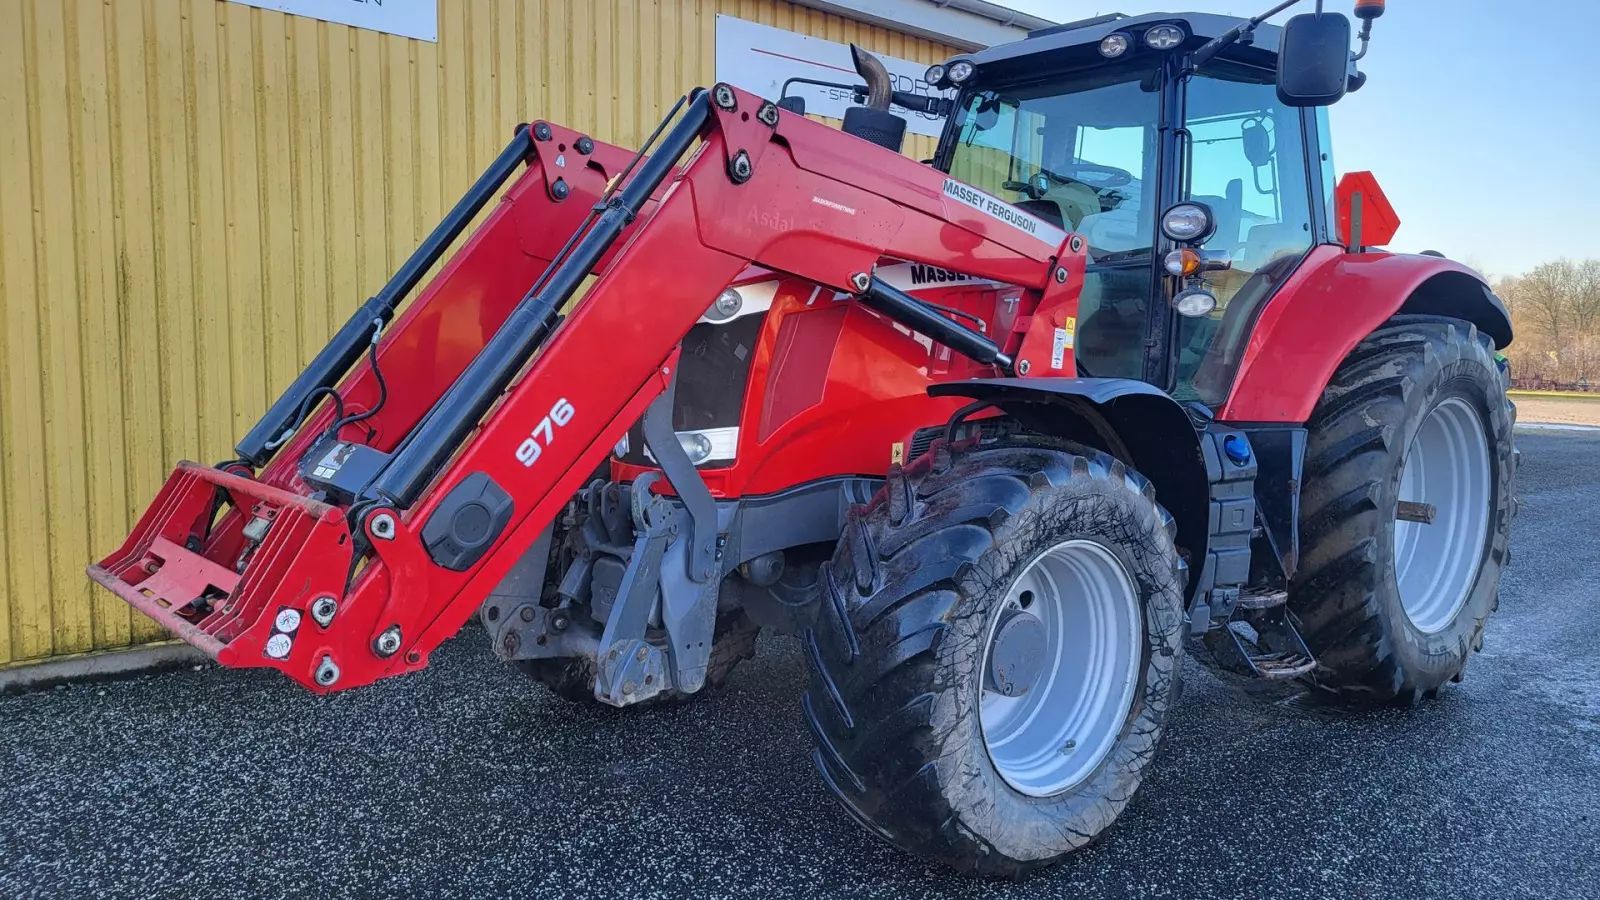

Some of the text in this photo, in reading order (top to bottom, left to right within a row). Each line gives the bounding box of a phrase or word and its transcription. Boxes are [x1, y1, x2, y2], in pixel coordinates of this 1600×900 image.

[943, 179, 1037, 233] MASSEY FERGUSON
[515, 397, 575, 468] 976
